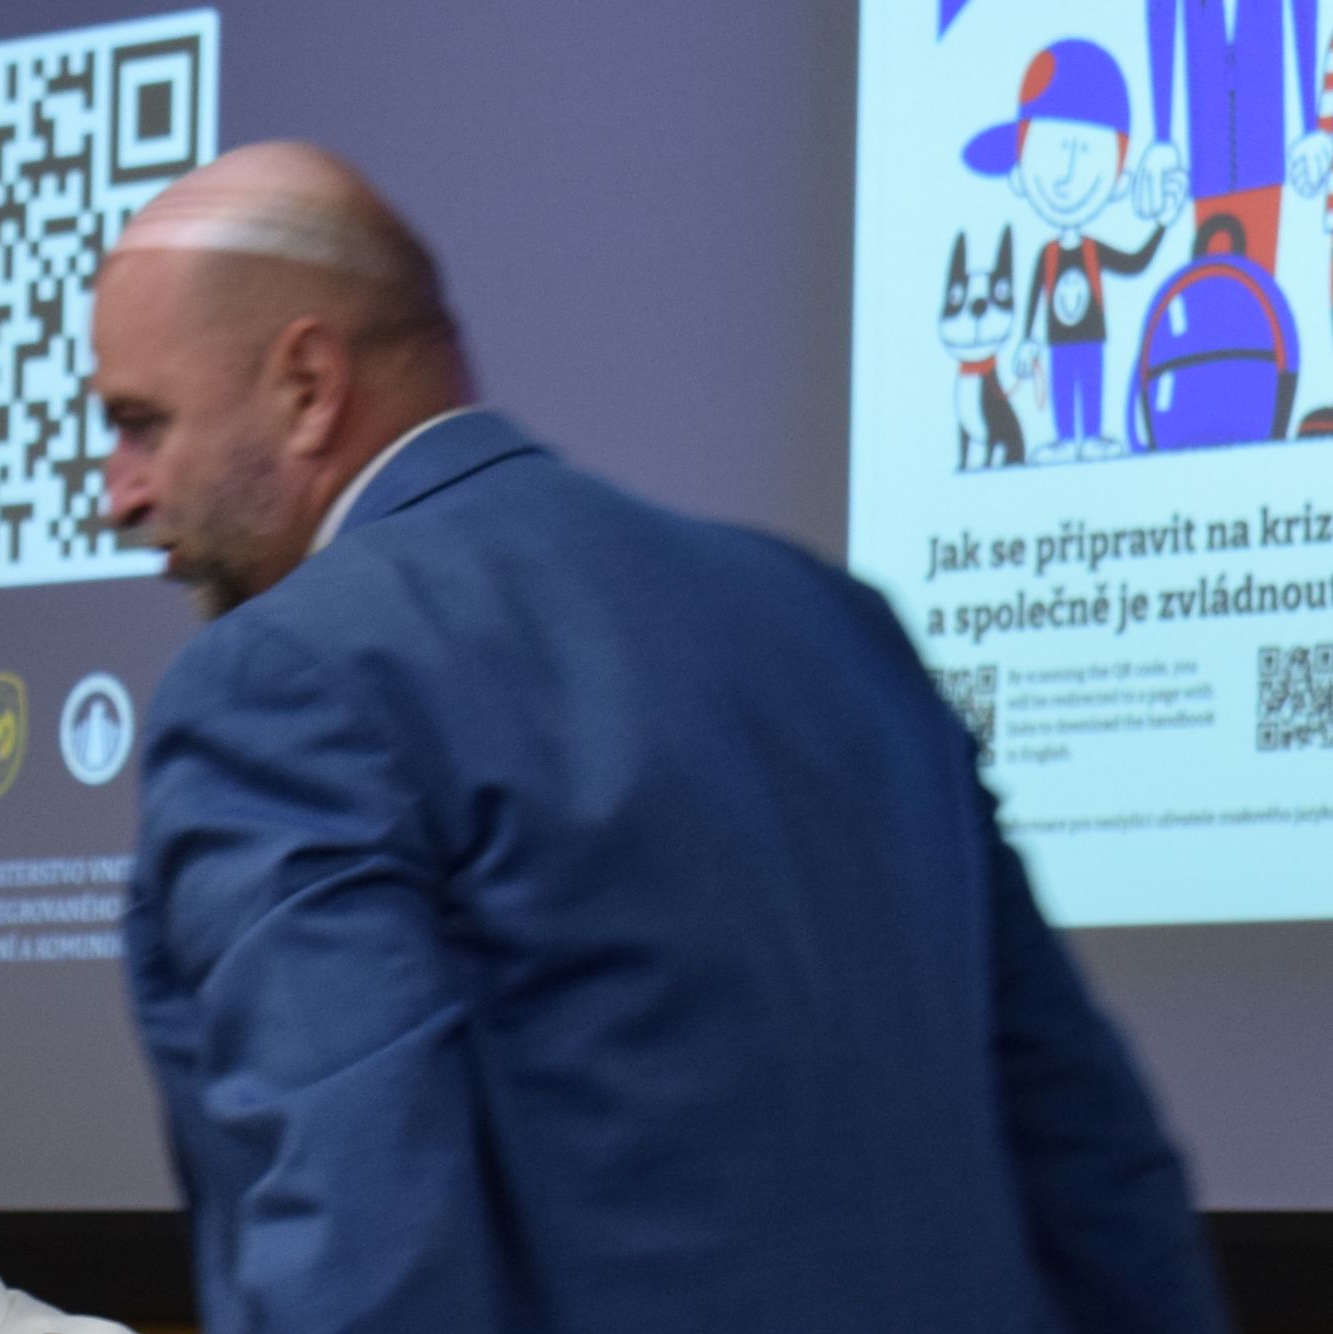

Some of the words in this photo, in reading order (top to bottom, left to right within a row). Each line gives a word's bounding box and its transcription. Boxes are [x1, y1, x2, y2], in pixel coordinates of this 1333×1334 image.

[926, 532, 981, 580] Jak
[990, 539, 1026, 568] se
[1036, 512, 1196, 577] připravit
[1206, 519, 1250, 550] na
[927, 607, 946, 636] a
[954, 587, 1109, 644] společně
[1117, 583, 1148, 634] je
[1158, 573, 1333, 622] zvládnou
